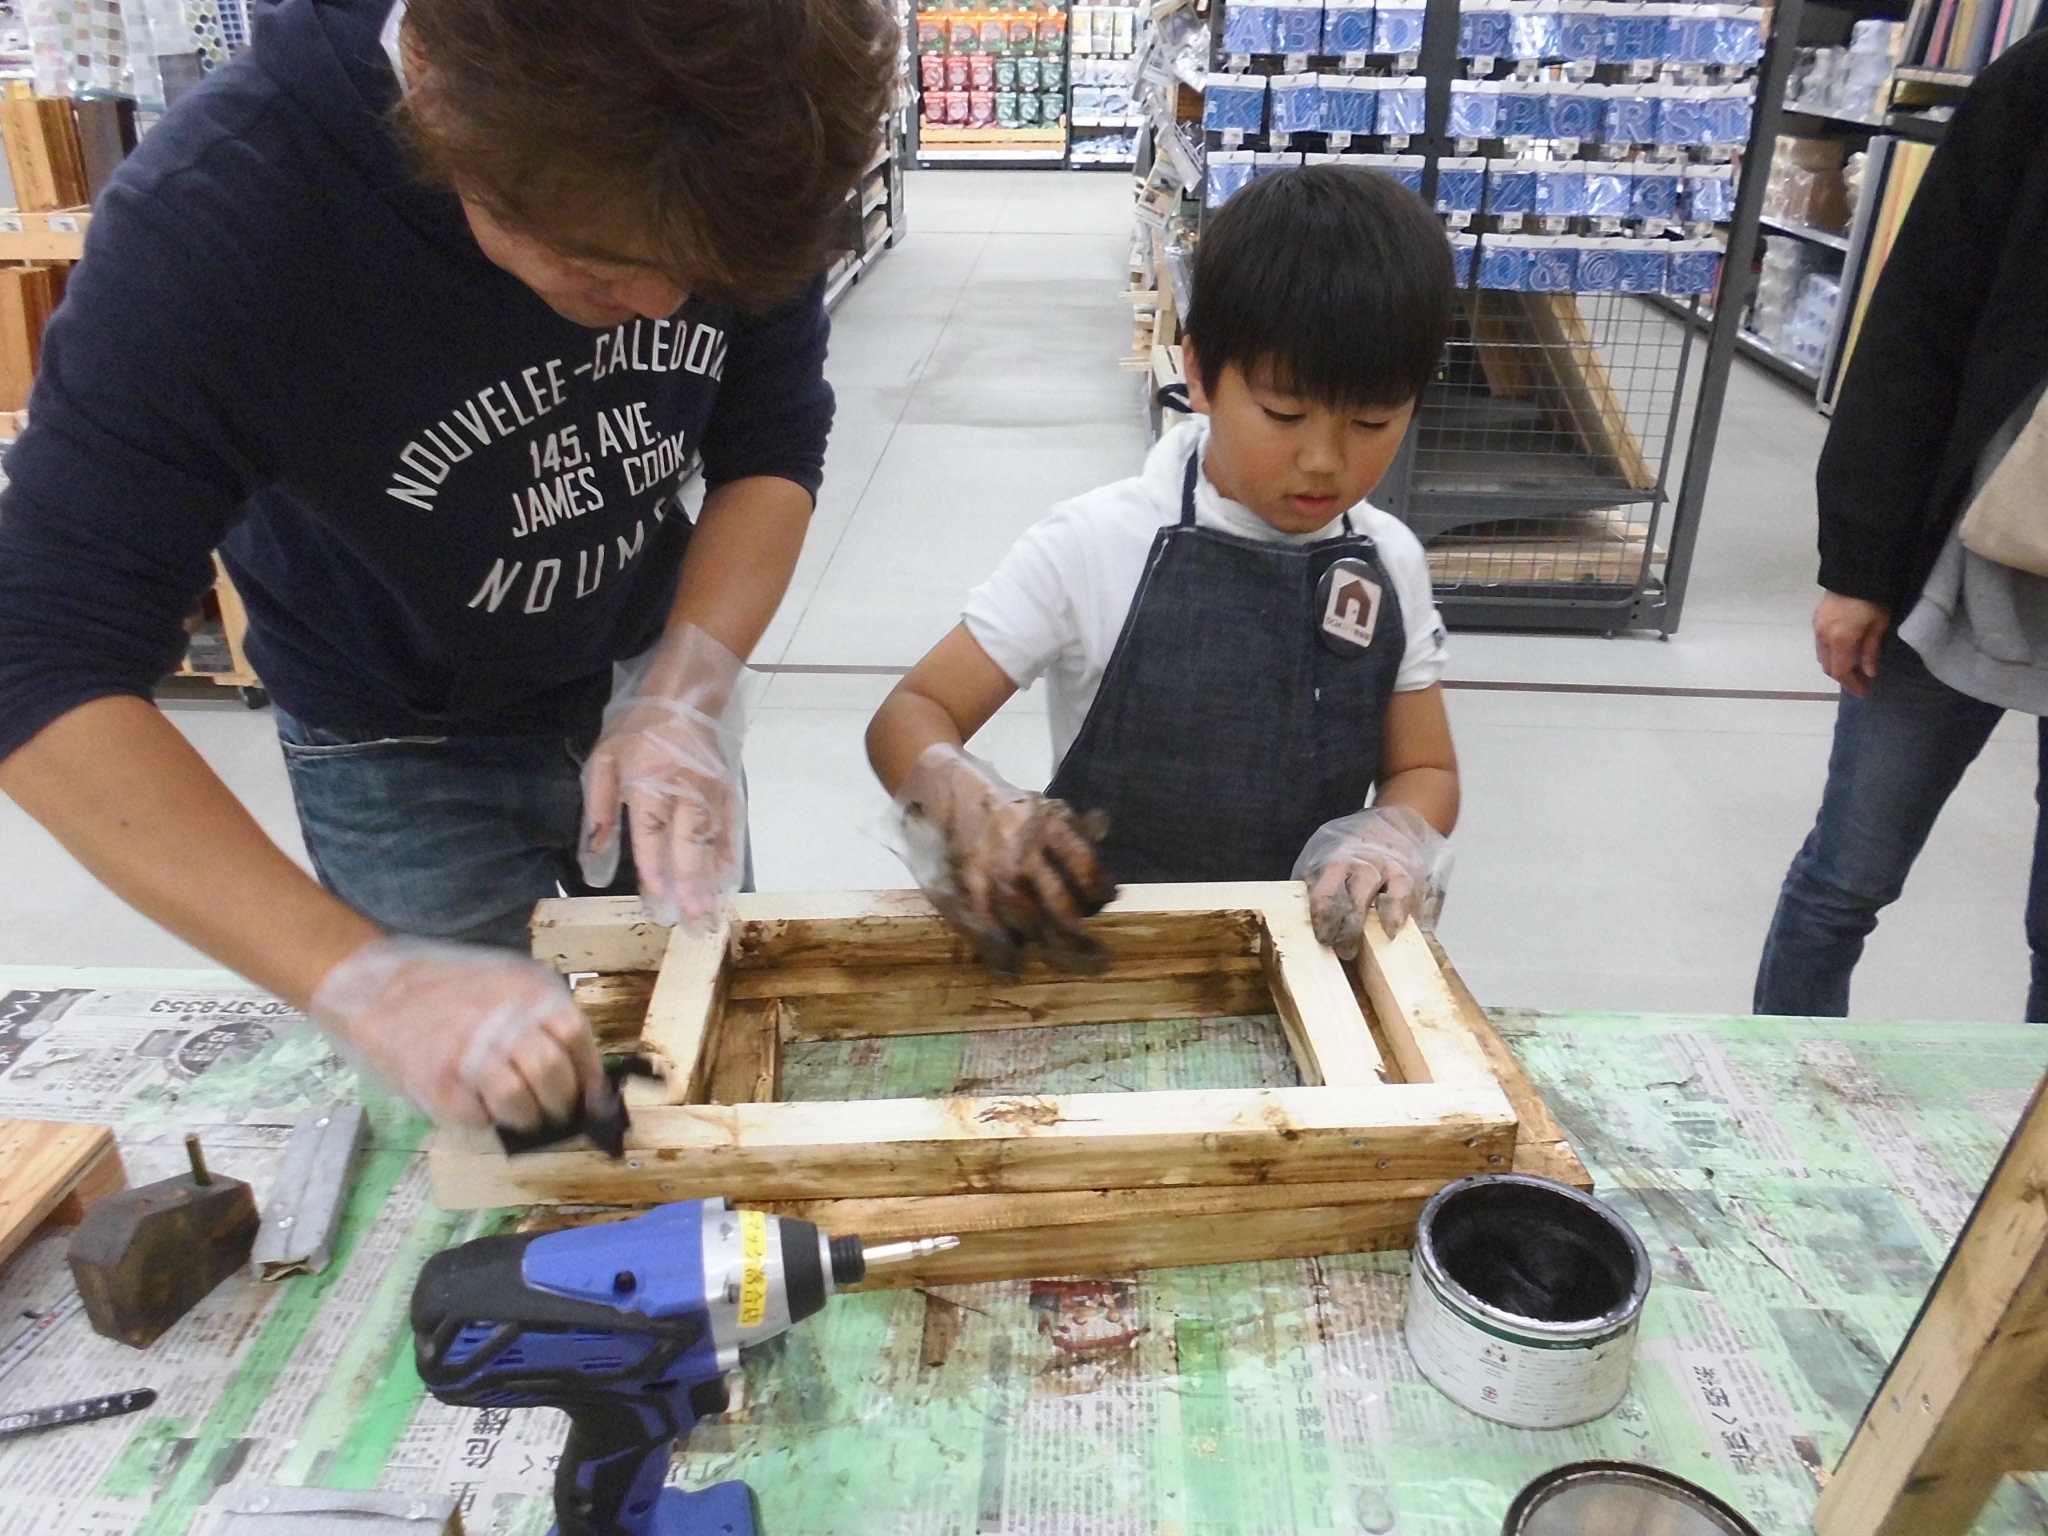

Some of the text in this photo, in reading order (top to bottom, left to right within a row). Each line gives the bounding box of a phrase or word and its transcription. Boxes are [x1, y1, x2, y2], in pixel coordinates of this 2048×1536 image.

[597, 401, 662, 458] AVE.
[512, 431, 686, 538] JAMES COOK
